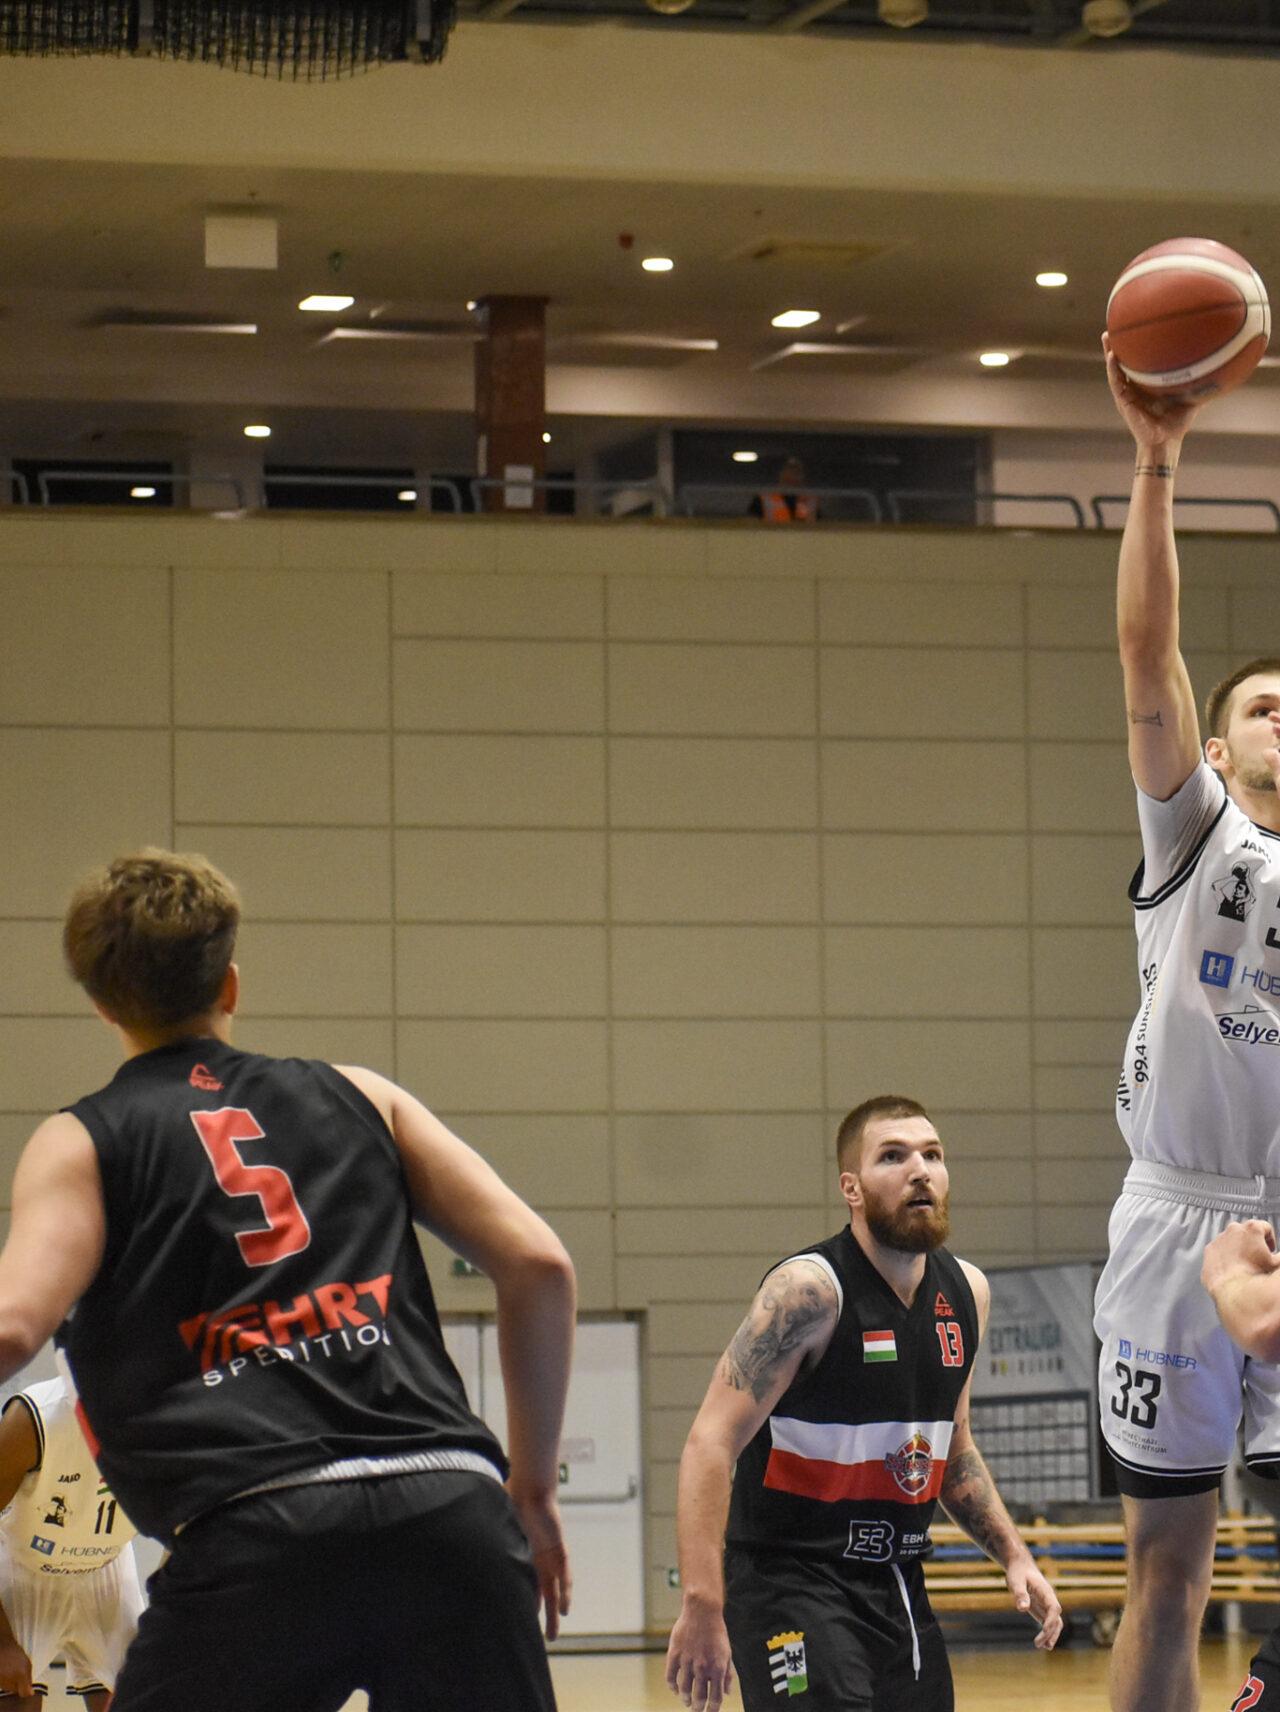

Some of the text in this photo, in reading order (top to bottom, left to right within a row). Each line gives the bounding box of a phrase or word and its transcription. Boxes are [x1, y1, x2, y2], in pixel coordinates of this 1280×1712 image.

[1134, 1044, 1149, 1083] 99.4
[190, 1106, 311, 1268] 5
[934, 1306, 955, 1317] PEAK
[935, 1322, 965, 1368] 13
[1111, 1360, 1162, 1430] 33
[95, 1499, 117, 1534] 11
[902, 1533, 924, 1544] EBH
